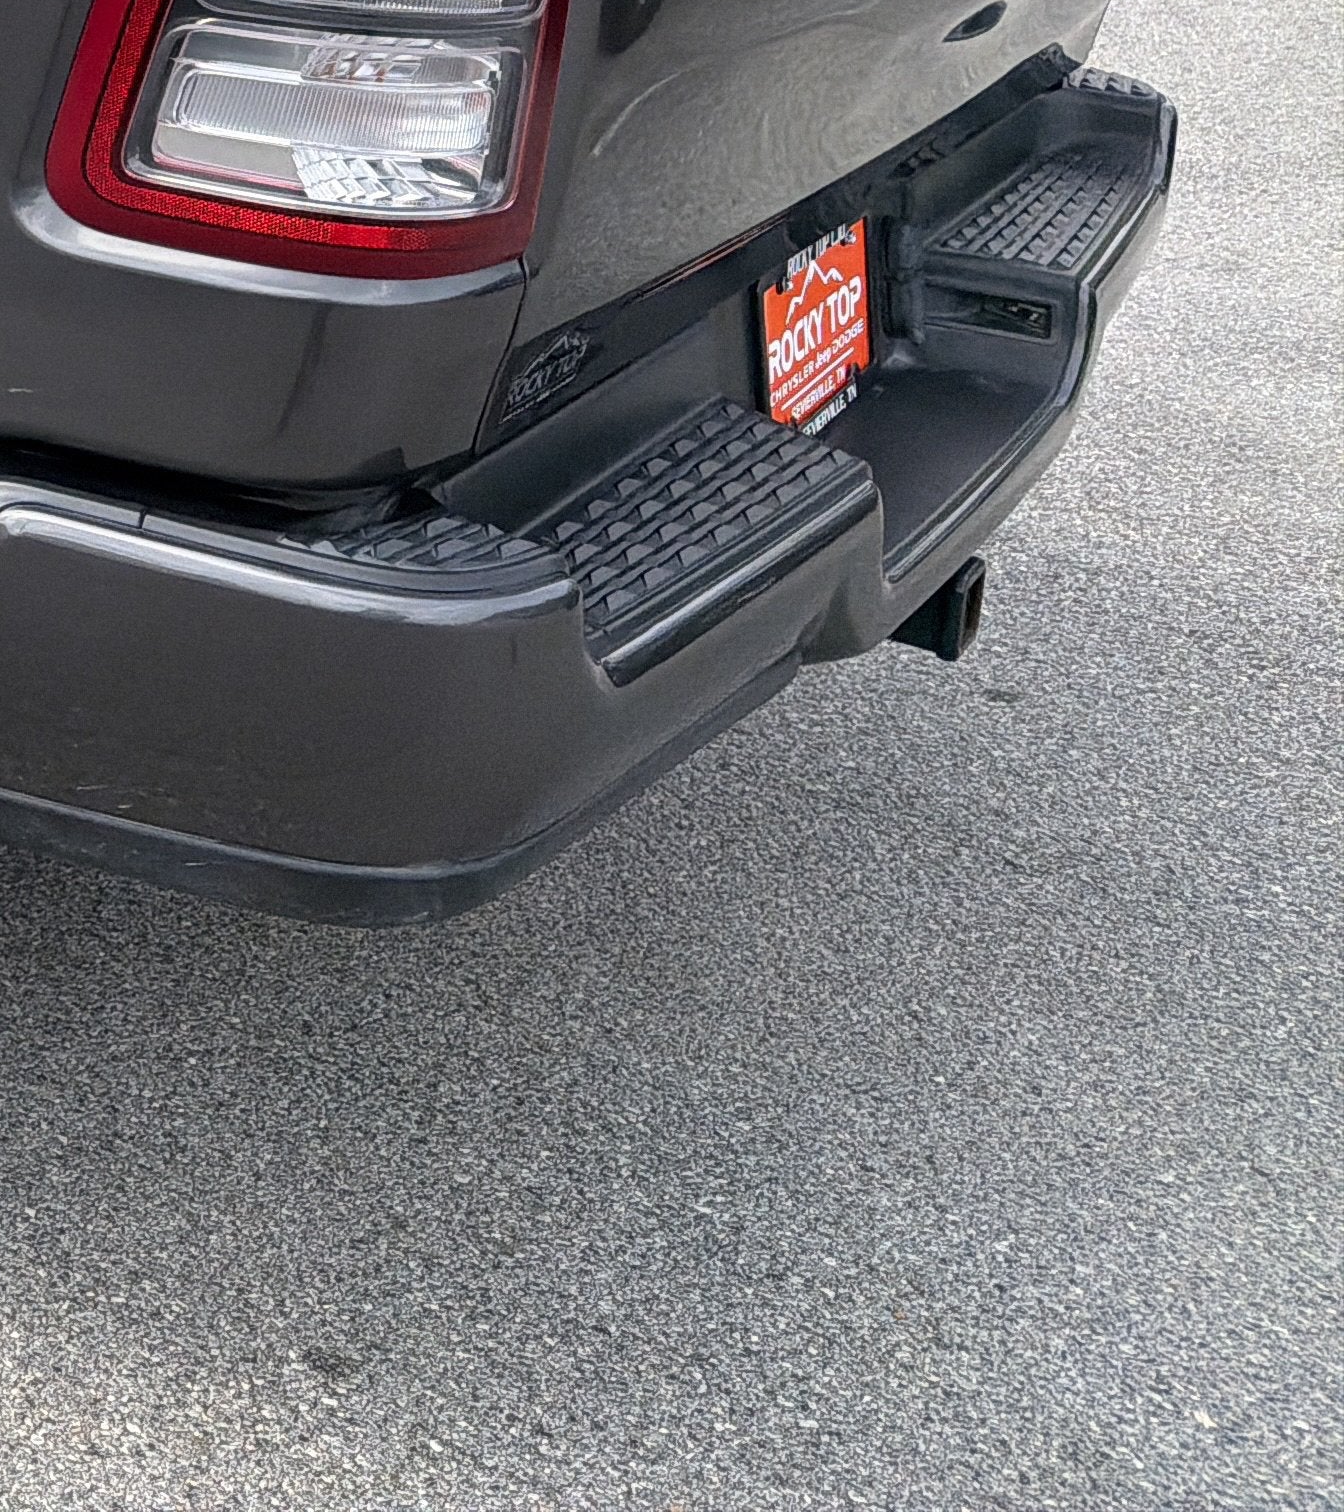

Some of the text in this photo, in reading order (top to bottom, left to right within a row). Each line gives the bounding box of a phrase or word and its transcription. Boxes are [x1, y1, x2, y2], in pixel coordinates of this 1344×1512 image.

[768, 276, 862, 385] ROCKY TOP
[770, 318, 865, 408] CHRYSLER Jeep DODGE
